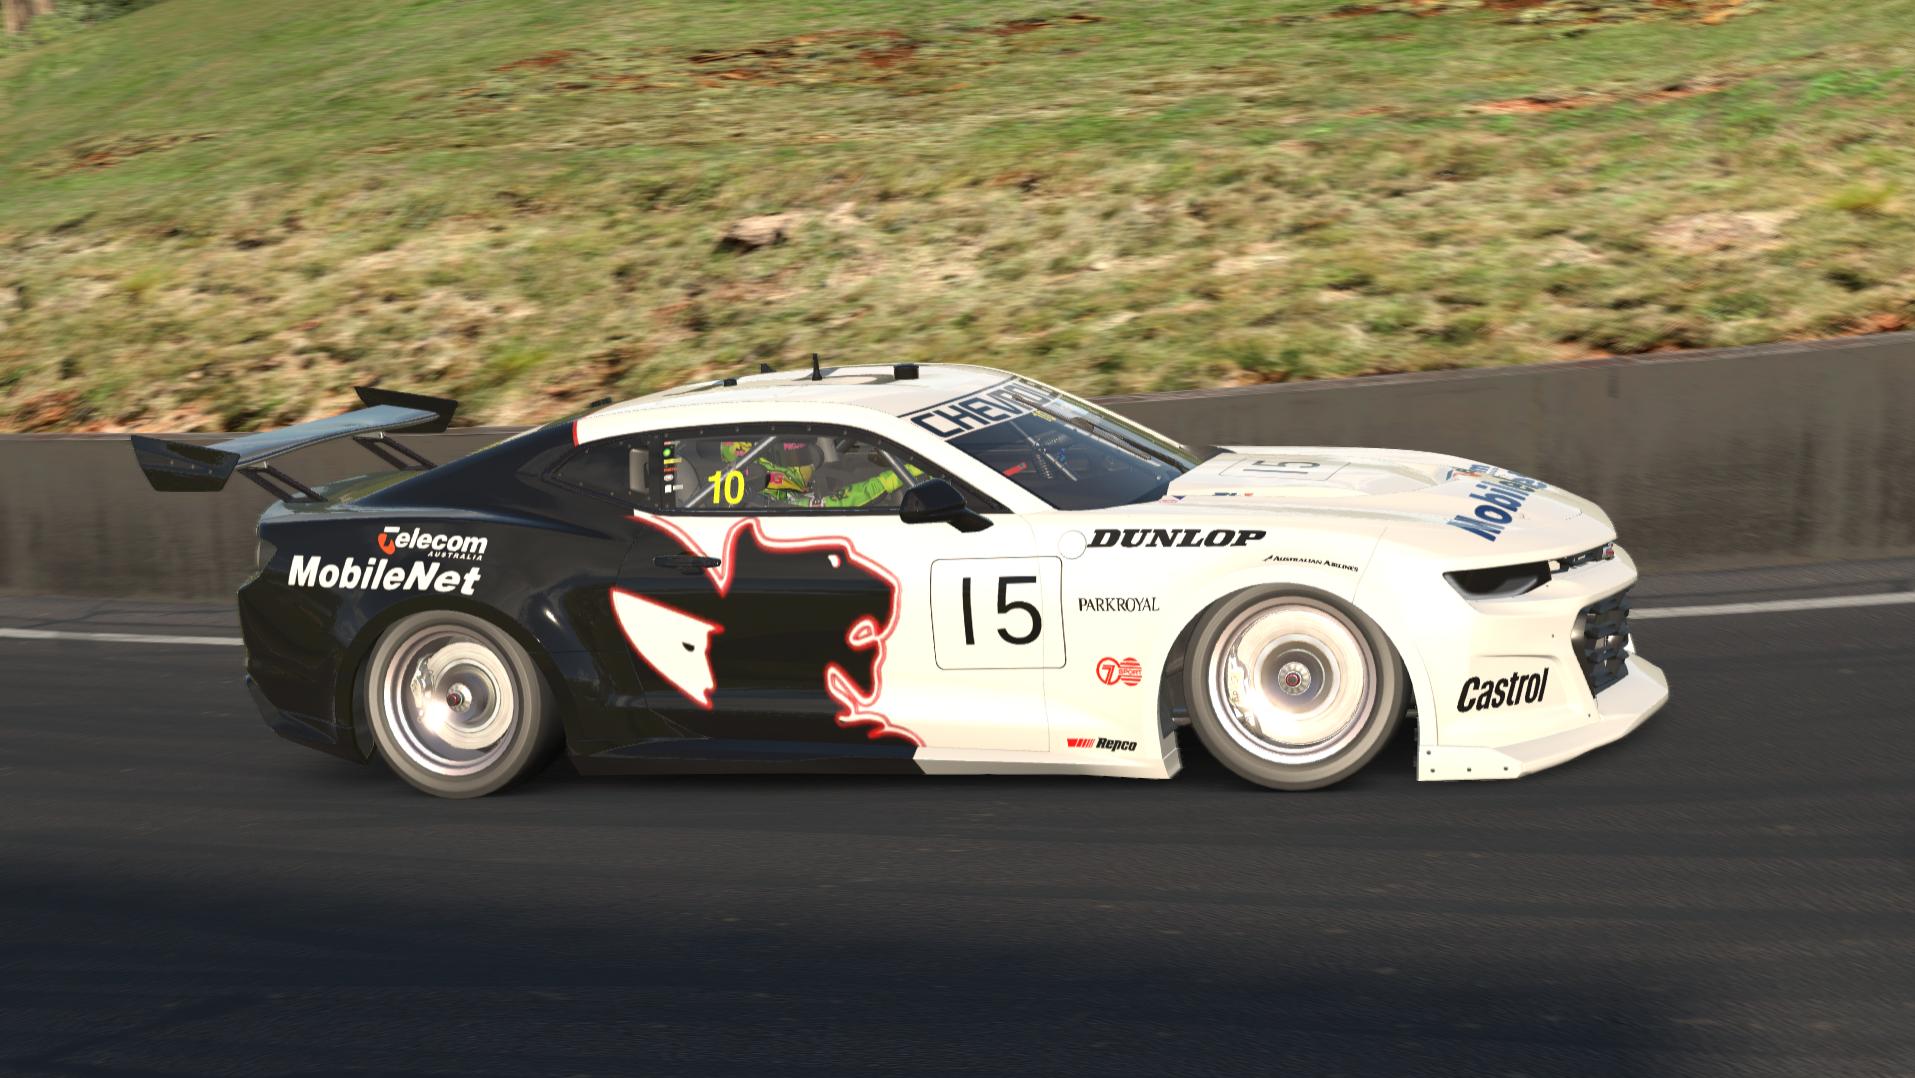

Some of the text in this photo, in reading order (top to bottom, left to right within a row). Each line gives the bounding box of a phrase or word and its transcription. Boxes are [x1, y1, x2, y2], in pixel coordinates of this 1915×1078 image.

[707, 469, 746, 505] 10
[377, 526, 489, 555] Telecom
[1087, 529, 1267, 548] DUNLOP
[427, 551, 483, 561] AUSTRALIA
[287, 554, 482, 596] MobileNet
[962, 575, 1042, 646] 15
[1078, 597, 1160, 612] PARKROYAL
[1456, 666, 1549, 713] Castrol
[1096, 737, 1138, 752] Repco
